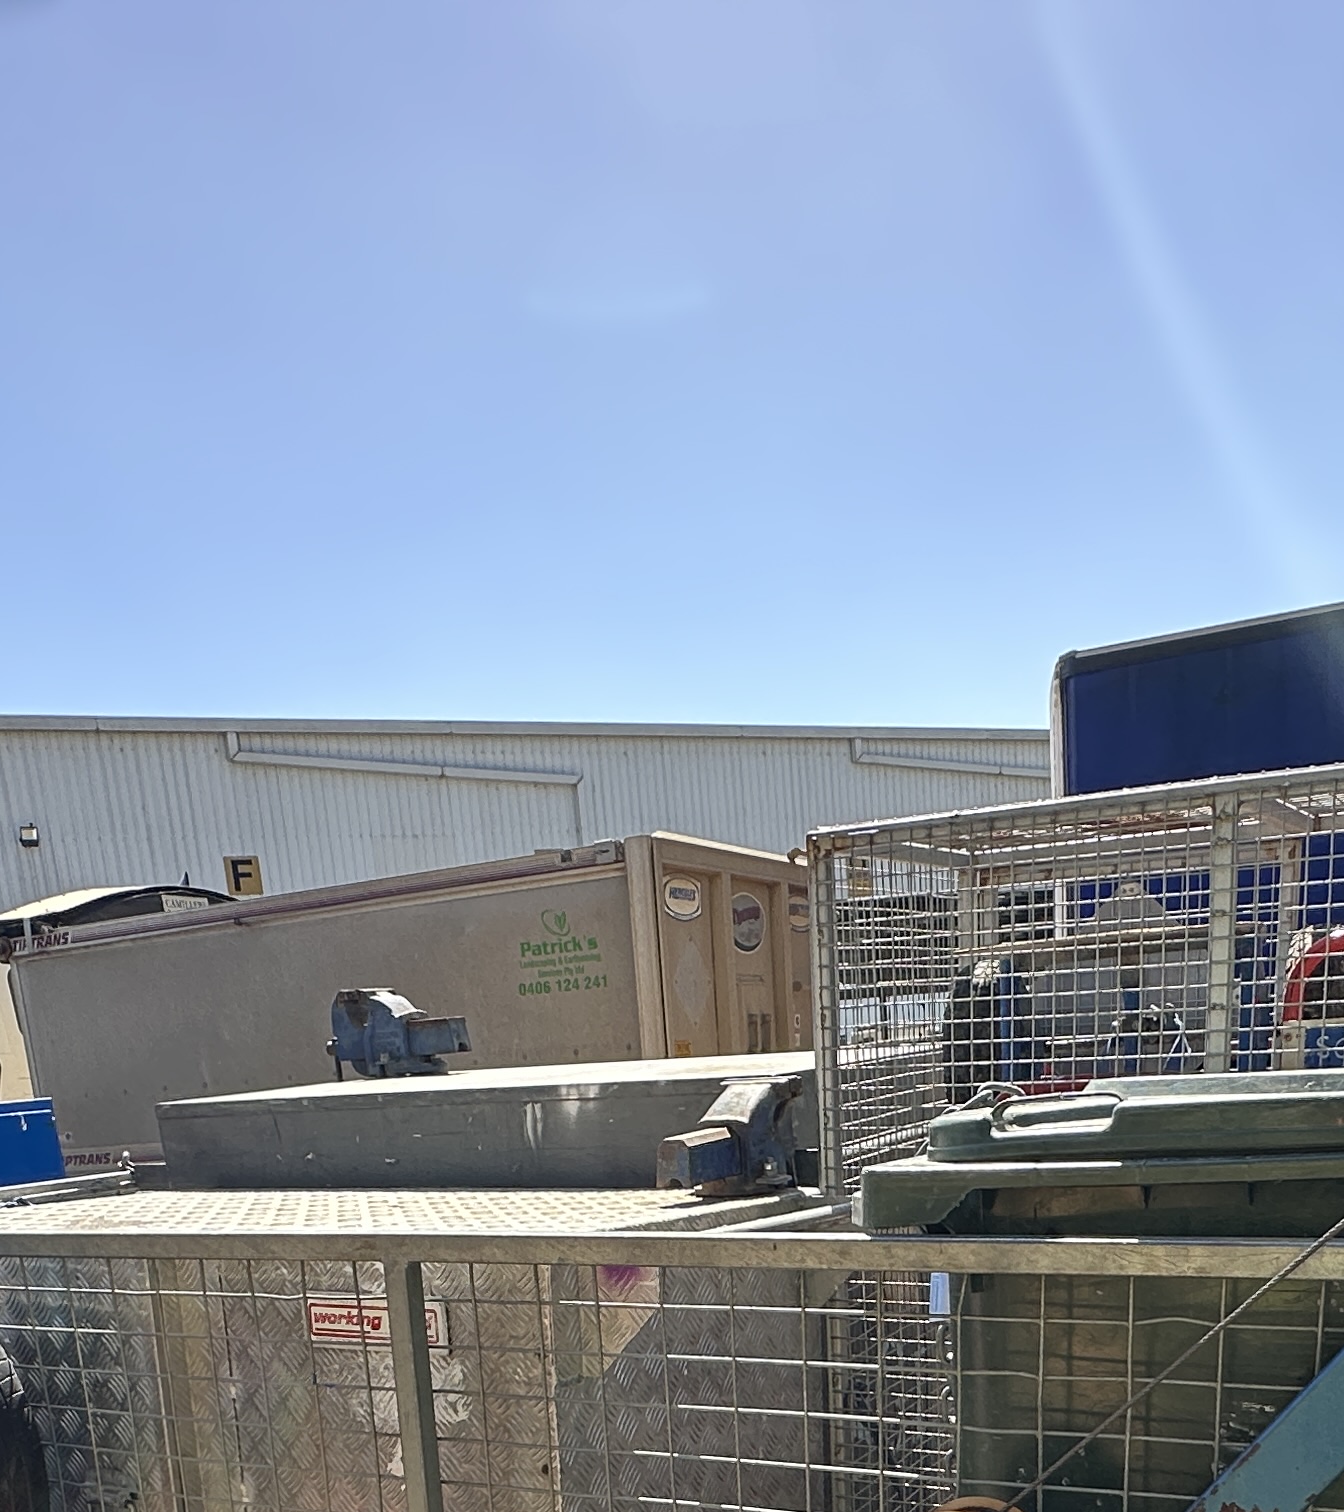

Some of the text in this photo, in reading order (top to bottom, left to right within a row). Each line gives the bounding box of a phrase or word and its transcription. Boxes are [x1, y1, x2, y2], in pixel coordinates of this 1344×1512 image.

[231, 859, 253, 892] F
[519, 935, 598, 957] Patrick's
[519, 974, 608, 996] 0406 124 241
